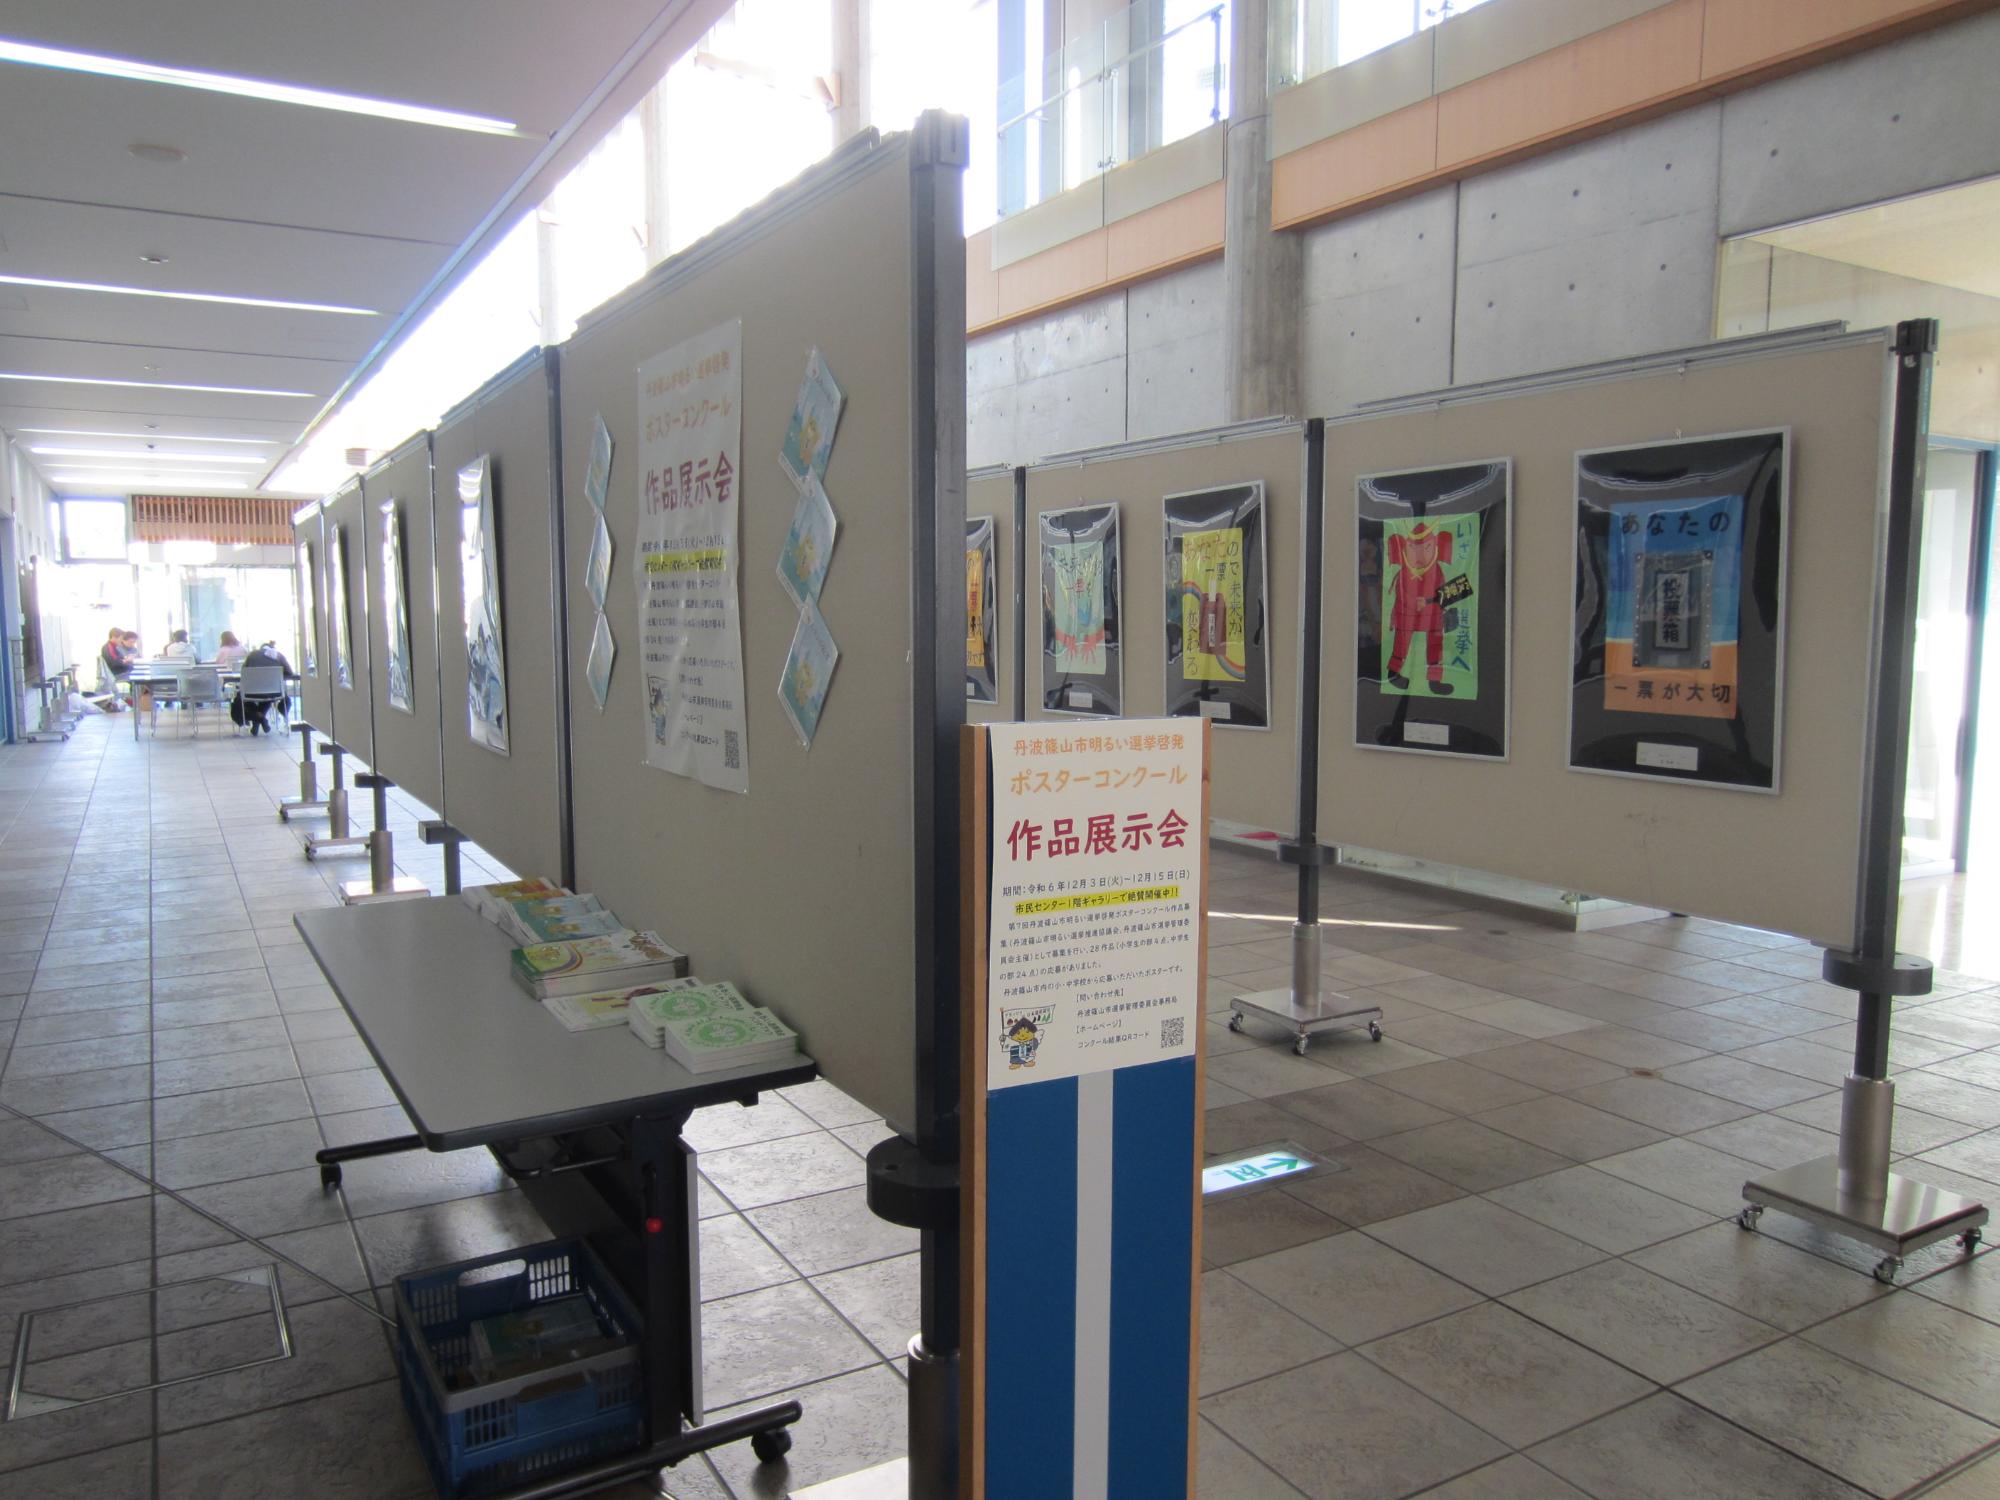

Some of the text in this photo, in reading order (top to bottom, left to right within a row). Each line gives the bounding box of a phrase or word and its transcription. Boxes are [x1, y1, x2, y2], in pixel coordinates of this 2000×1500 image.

[645, 450, 734, 516] 作品展示会
[1621, 511, 1731, 537] あなたの
[1661, 577, 1681, 644] 投票箱
[1613, 680, 1731, 703] 一票が大切
[1014, 734, 1184, 756] 丹波篠山市明るい選挙啓発
[1011, 765, 1188, 795] ポスターコンクール
[1007, 808, 1189, 862] 作品展示会
